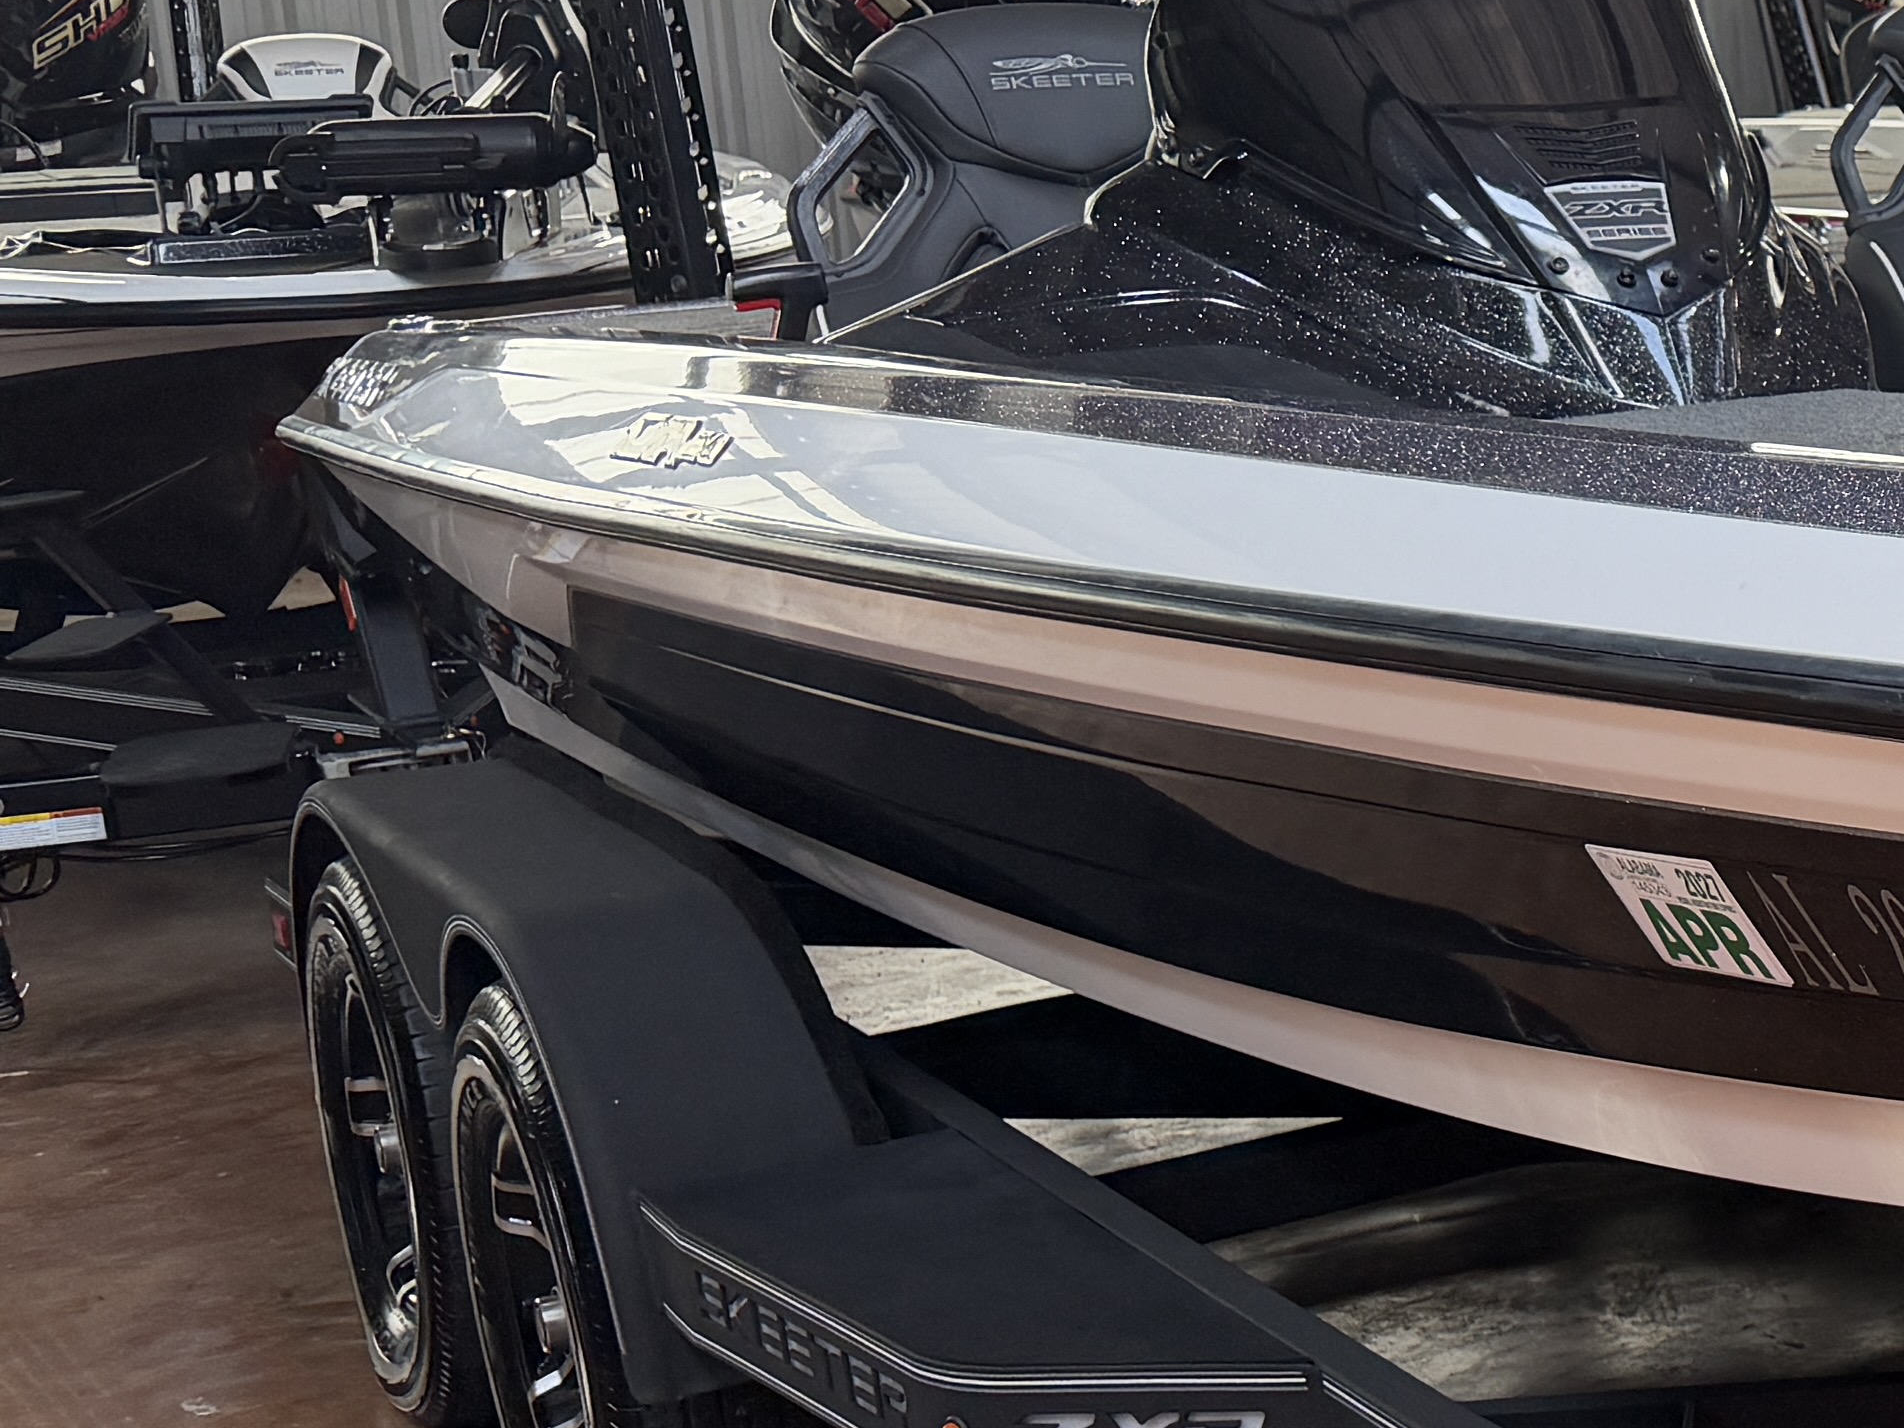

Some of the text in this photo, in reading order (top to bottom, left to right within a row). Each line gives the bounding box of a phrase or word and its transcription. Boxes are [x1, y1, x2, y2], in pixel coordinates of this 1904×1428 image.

[991, 73, 1135, 90] SKEETER
[1564, 198, 1669, 220] ZXR
[1583, 224, 1669, 240] SERIES
[1674, 868, 1726, 903] 2027
[1639, 898, 1777, 980] APR
[1747, 872, 1880, 996] AL
